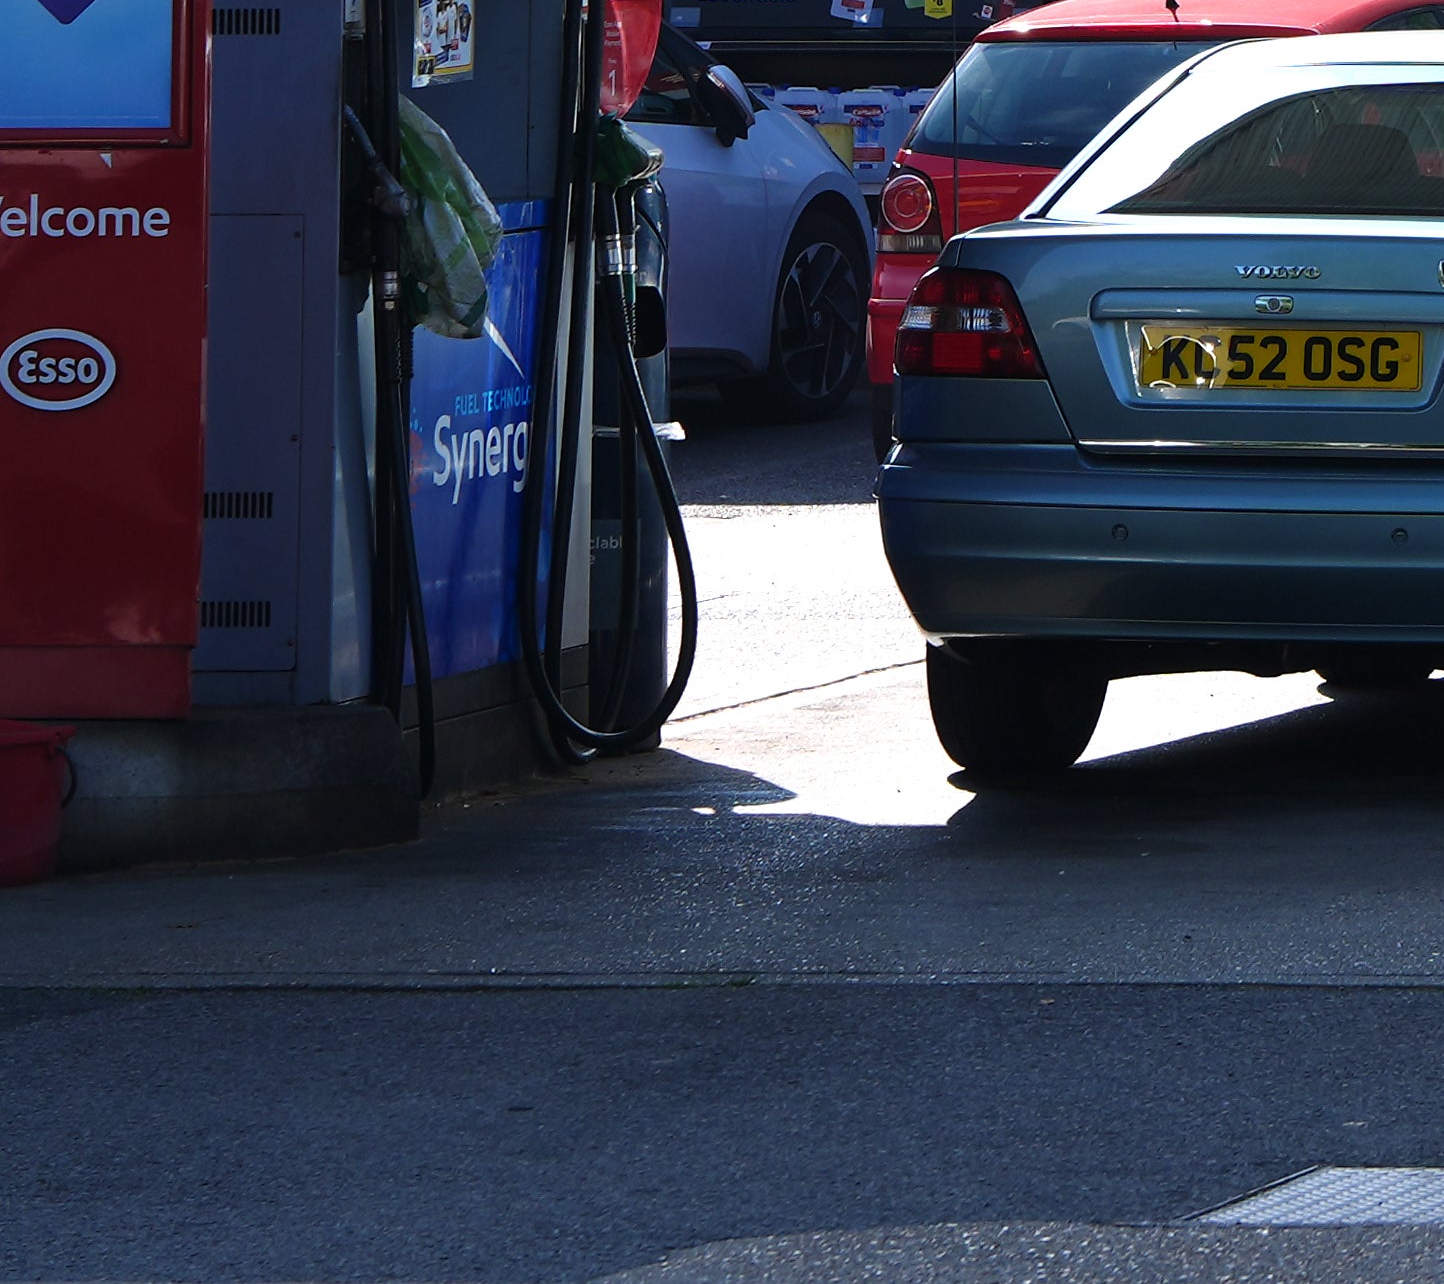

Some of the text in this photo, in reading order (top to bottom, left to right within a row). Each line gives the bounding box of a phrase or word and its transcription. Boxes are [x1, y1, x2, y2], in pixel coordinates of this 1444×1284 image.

[608, 69, 616, 96] 1
[0, 194, 171, 238] elcome
[1234, 265, 1322, 279] VOLVO
[17, 348, 99, 385] Esso
[1162, 334, 1400, 383] KC52 OSG
[455, 390, 479, 415] FUEL
[433, 413, 531, 504] Synerg
